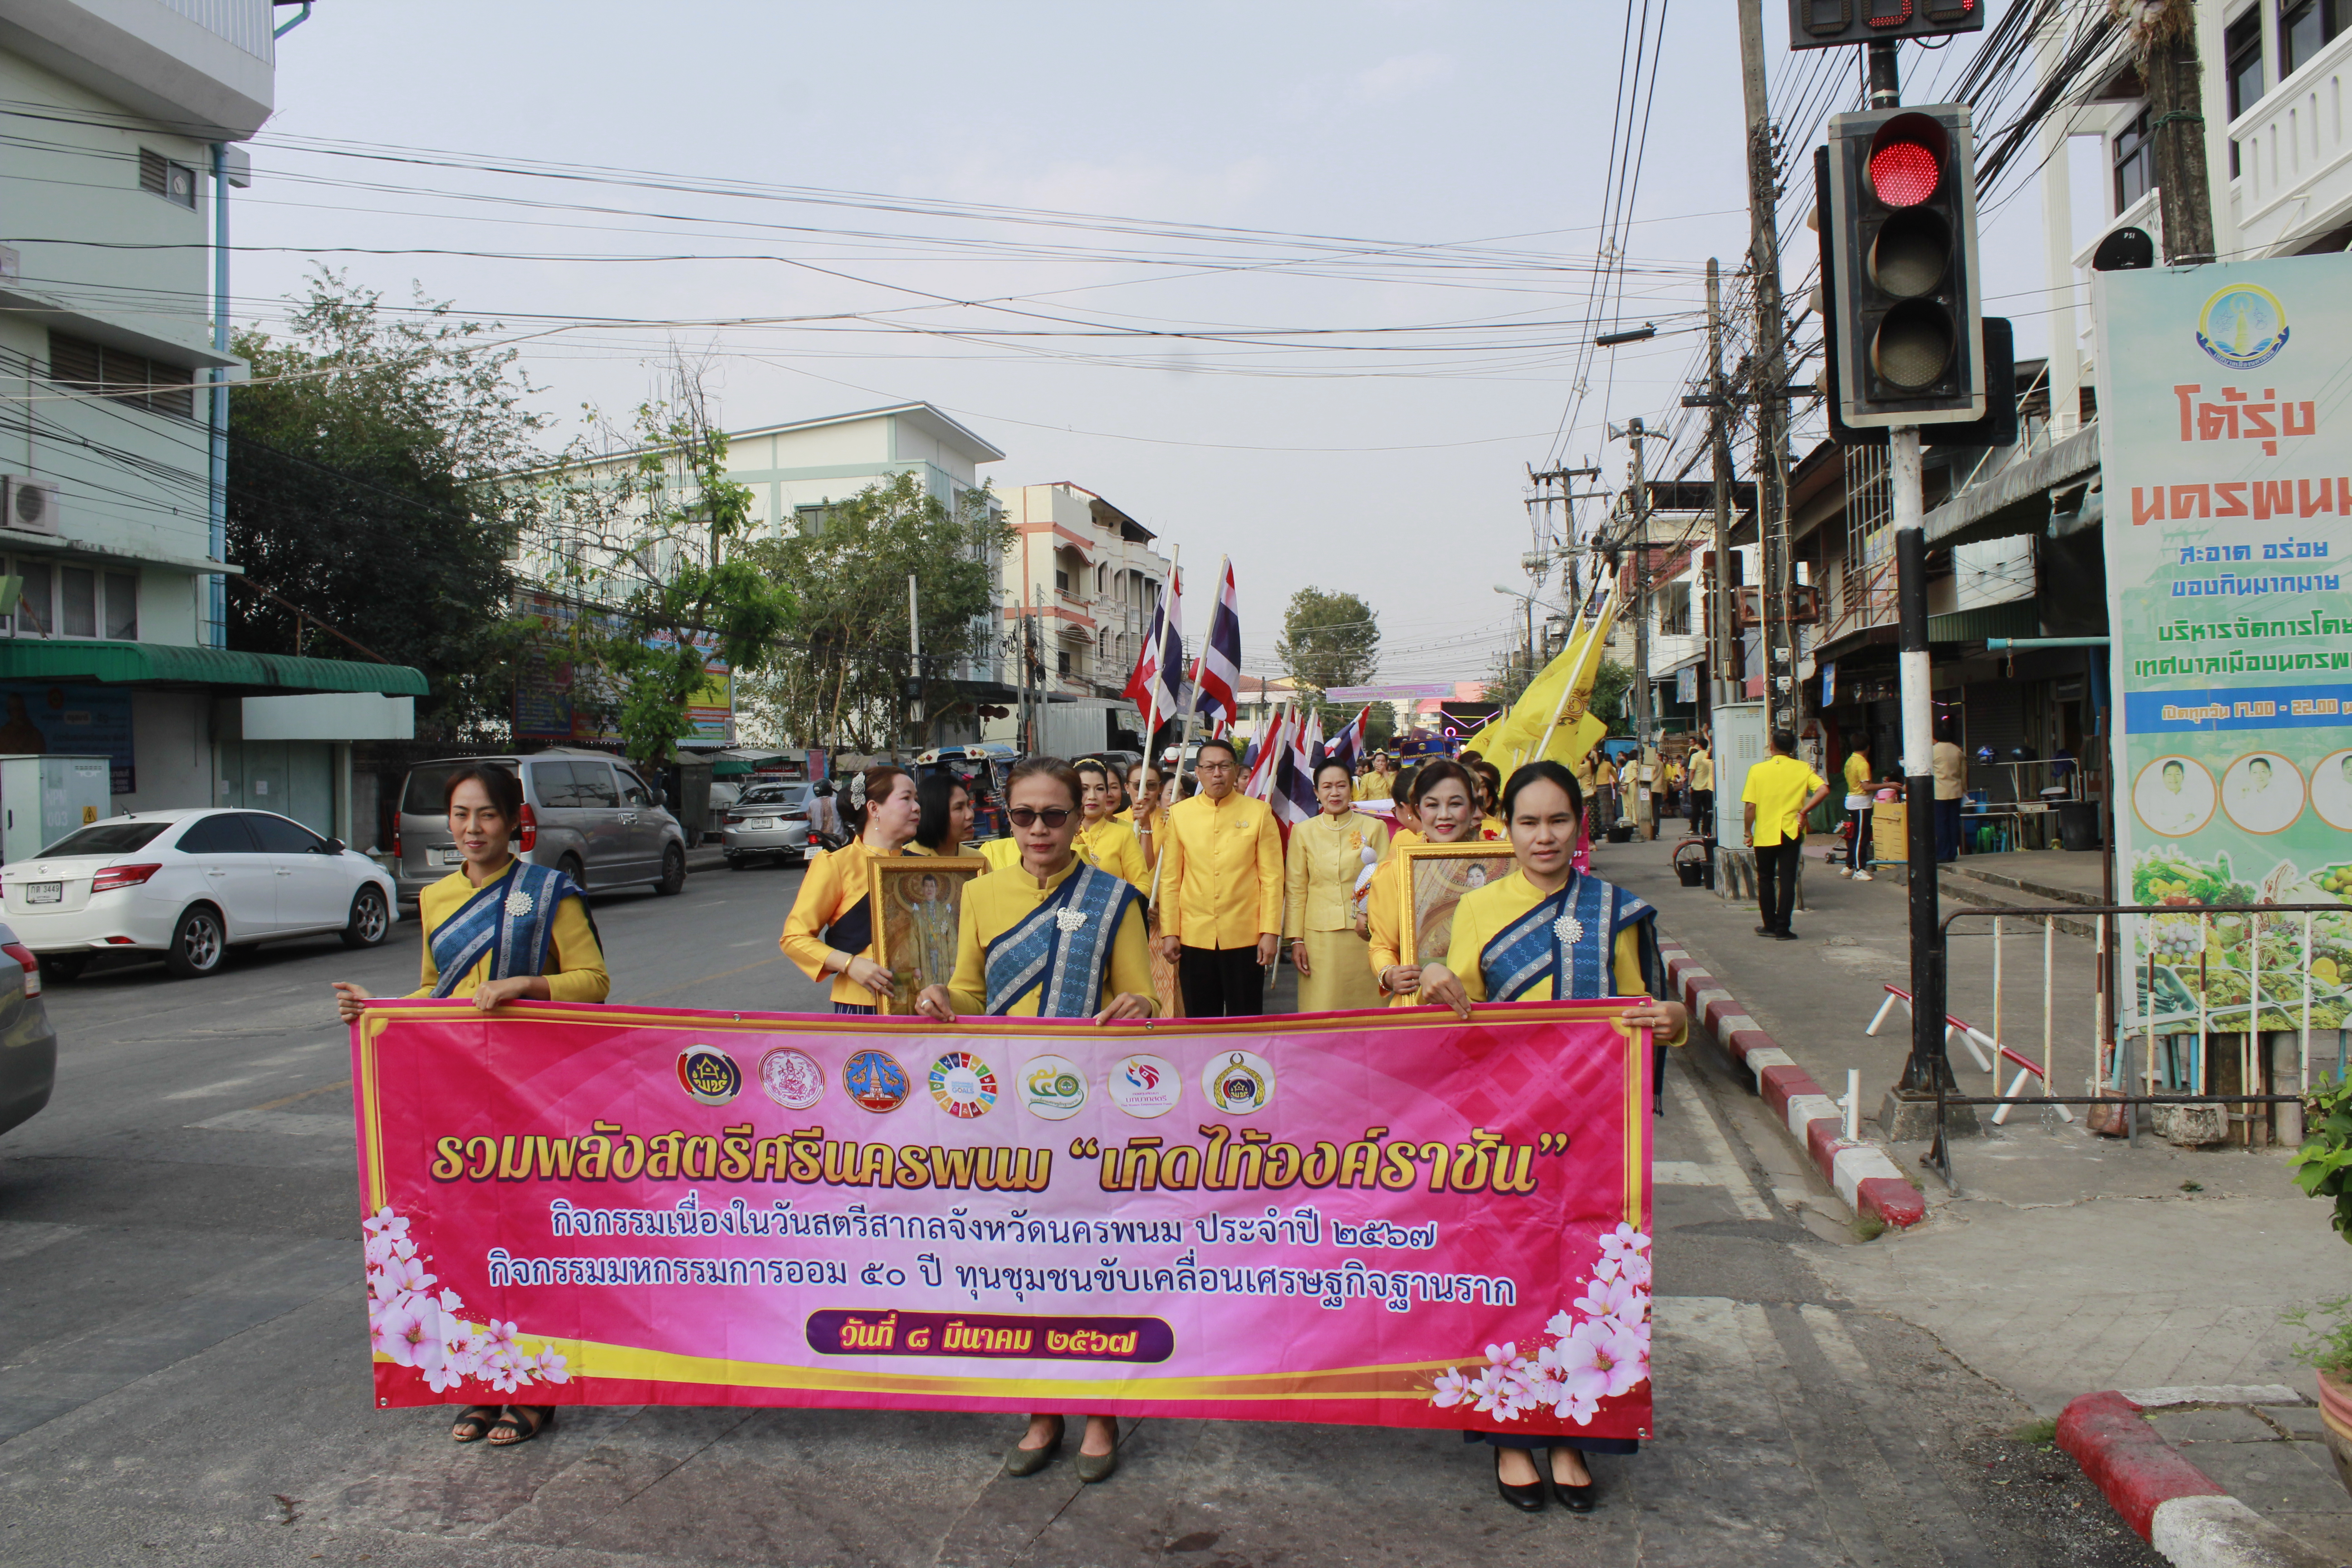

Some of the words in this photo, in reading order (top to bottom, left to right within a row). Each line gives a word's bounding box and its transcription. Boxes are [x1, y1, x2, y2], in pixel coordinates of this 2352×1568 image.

[2213, 349, 2274, 368] เทศบาลเมืองนครพนม
[2174, 384, 2316, 456] โต้รุ่ง
[2179, 544, 2251, 566] สะอาด
[2263, 537, 2328, 560] อร่อย
[2171, 573, 2339, 597] ของกินมากมาย
[2134, 649, 2352, 678] เทศบาลเมืองนครพ
[2161, 702, 2230, 725] เปิดทุกวัน
[2234, 701, 2275, 718] 17.00
[2291, 699, 2337, 715] 22.00
[47, 811, 68, 827] 003
[44, 885, 59, 893] 3449
[1126, 1095, 1167, 1103] บทบาทสตรี
[431, 1121, 1053, 1192] รวมพลังสตรีศรีนครพนม
[1069, 1124, 1570, 1194] “เทิดไท้องค์ราชัน”
[551, 1189, 1182, 1245] กิจกรรมเนื่องในวันสตรีสากลจังหวัดนครพนม
[1195, 1208, 1320, 1245] ประจำปี
[1332, 1220, 1437, 1250] ๒๕๖๗
[488, 1247, 847, 1287] กิจกรรมมหกรรมการออม
[858, 1264, 905, 1288] ๕๐
[918, 1253, 941, 1287] ปี
[955, 1250, 1516, 1311] ทุนชุมชนขับเคลื่อนเศรษฐกิจฐานราก
[840, 1313, 894, 1350] วันที่
[907, 1327, 929, 1350] ๘
[942, 1319, 1030, 1352] มีนาคม
[1045, 1329, 1138, 1354] ๒๕๖๗
